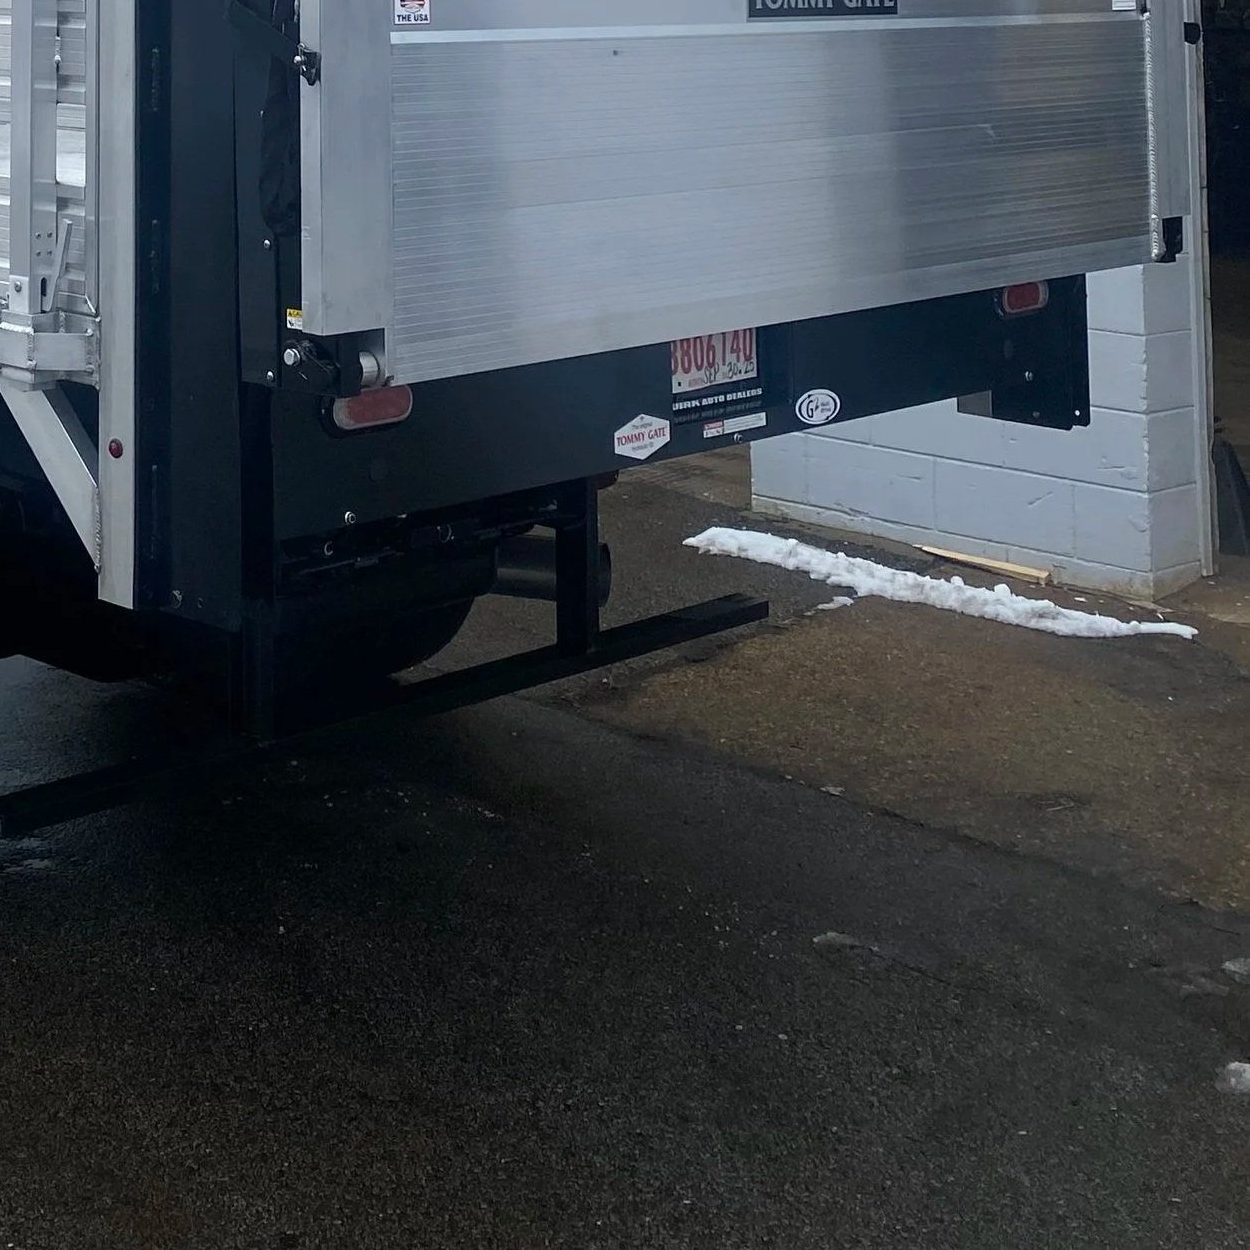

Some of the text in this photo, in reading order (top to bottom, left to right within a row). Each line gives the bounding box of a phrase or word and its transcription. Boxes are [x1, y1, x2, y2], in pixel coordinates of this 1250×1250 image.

[397, 14, 411, 22] THE
[701, 394, 725, 406] AUTO
[726, 388, 763, 401] DEALERS
[617, 432, 645, 446] TOMMY
[648, 427, 666, 440] GATE
